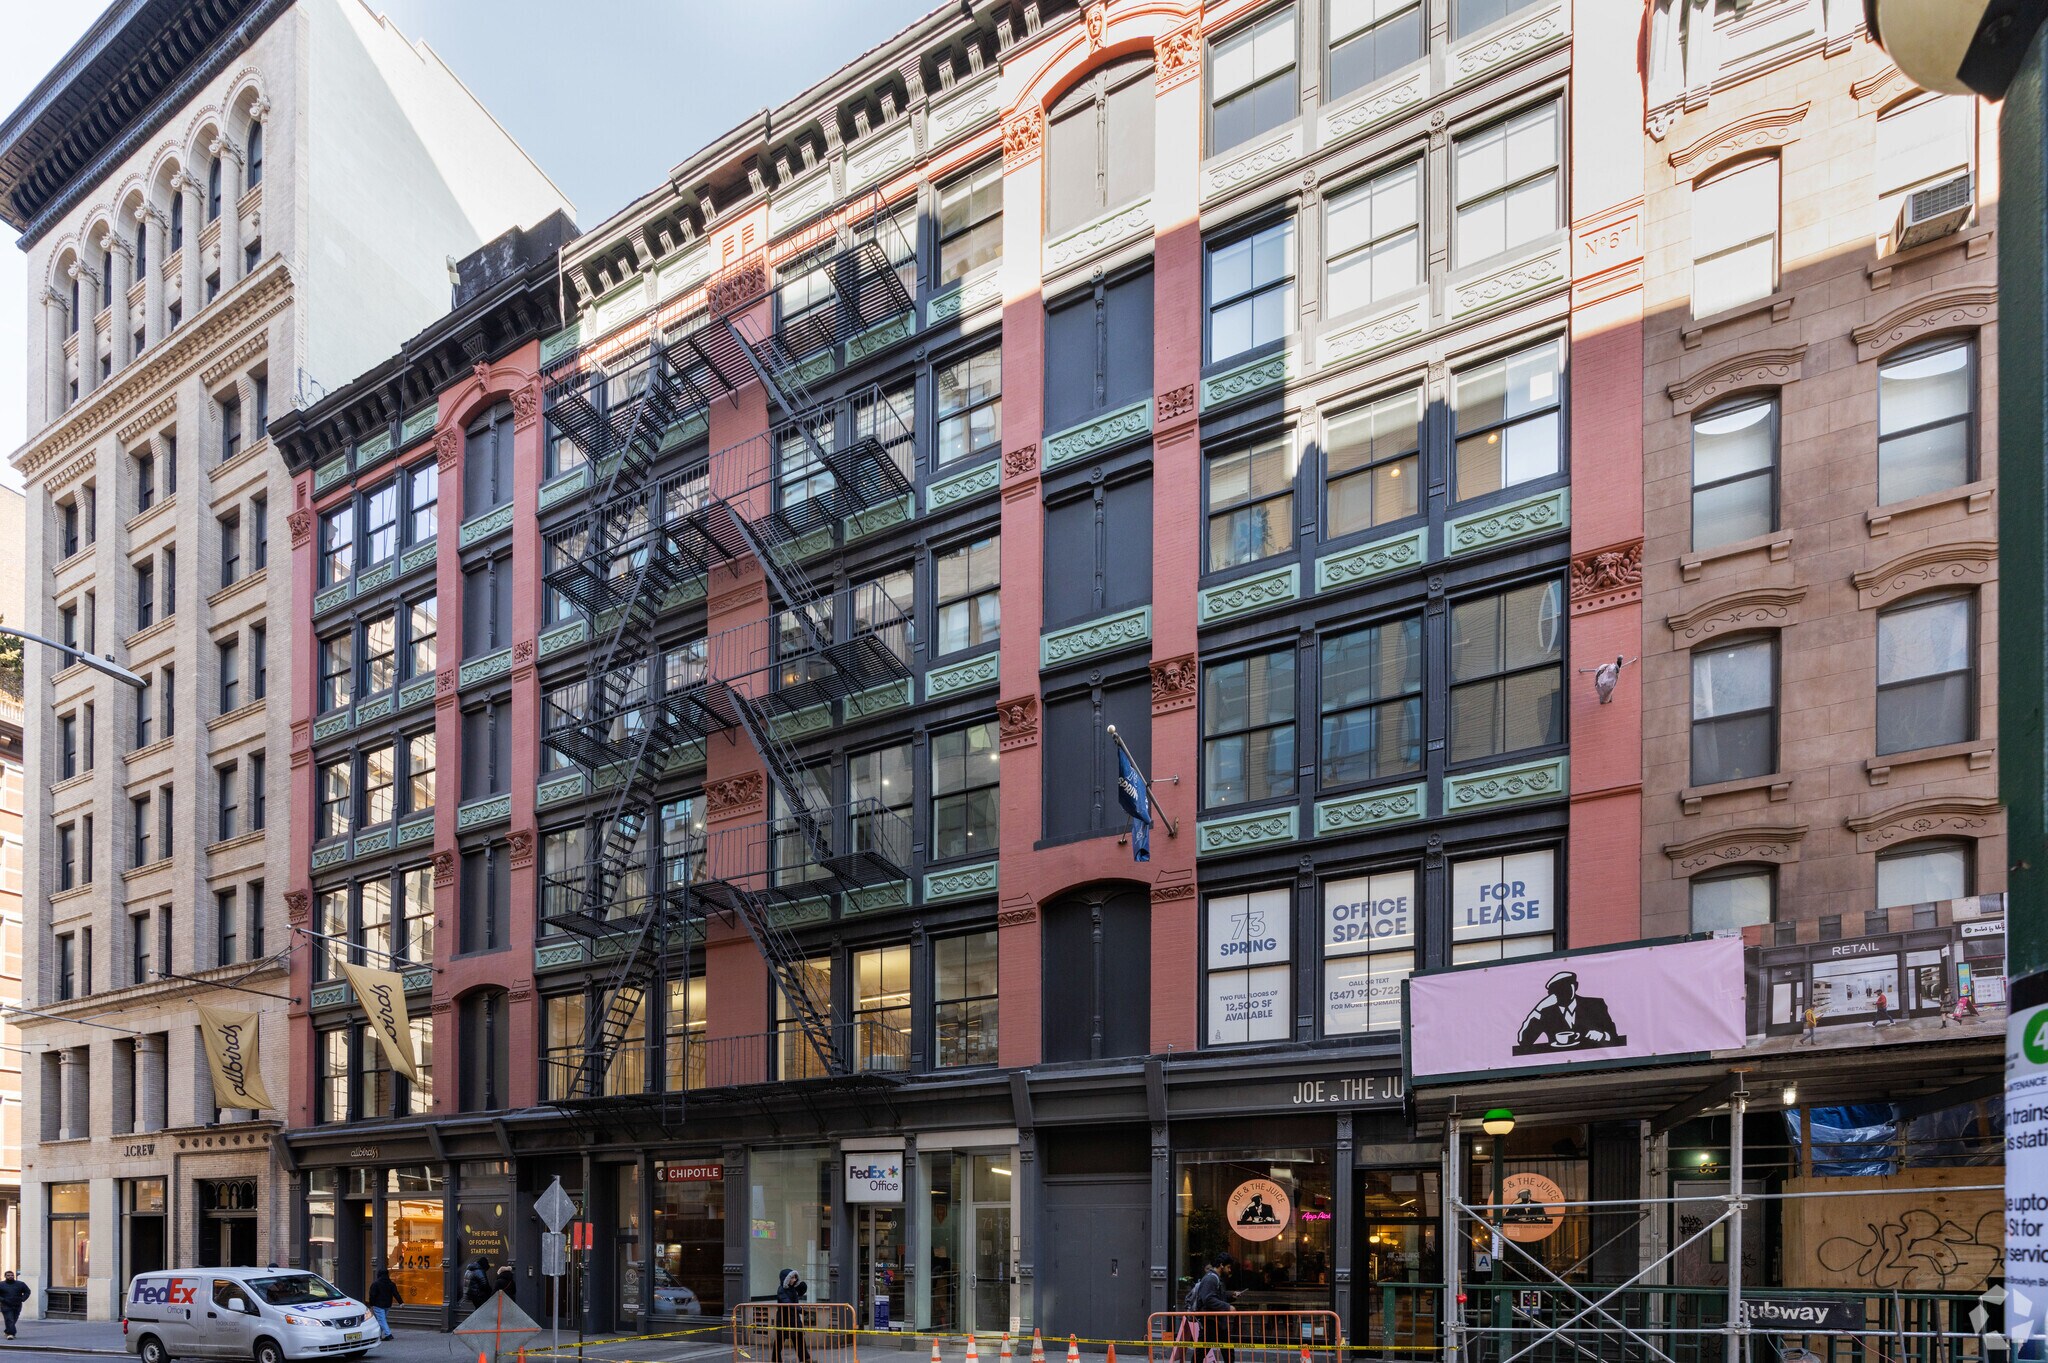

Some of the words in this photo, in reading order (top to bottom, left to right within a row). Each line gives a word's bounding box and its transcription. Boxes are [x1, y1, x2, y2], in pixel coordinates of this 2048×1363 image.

[1480, 881, 1526, 902] FOR
[1332, 896, 1407, 921] OFFICE
[1467, 900, 1539, 925] LEASE
[1231, 911, 1266, 940] 73
[1332, 917, 1407, 943] SPACE
[1220, 938, 1277, 956] SPRING
[1832, 942, 1880, 956] RETAIL
[1329, 989, 1355, 1001] (347)
[1357, 986, 1400, 998] 920-722
[1225, 1000, 1259, 1011] 12,500
[1262, 999, 1272, 1008] SF
[1225, 1009, 1273, 1022] AVAILABLE
[218, 1024, 247, 1097] allbirds
[1293, 1081, 1325, 1104] JOE
[1329, 1094, 1339, 1102] &
[1340, 1077, 1375, 1101] THE
[1382, 1076, 1404, 1098] JU
[124, 1144, 156, 1158] J.CREW
[669, 1167, 719, 1179] CHIPOTLE
[850, 1165, 886, 1179] FedEx
[1700, 1162, 1718, 1174] 65
[869, 1180, 898, 1191] Office
[1507, 1180, 1516, 1189] &
[1517, 1177, 1536, 1185] THE
[1536, 1181, 1560, 1201] JUICE
[1231, 1191, 1244, 1206] JOE
[1243, 1186, 1250, 1194] &
[1250, 1183, 1265, 1191] THE
[1265, 1186, 1286, 1204] JUICE
[2021, 1218, 2043, 1237] for
[658, 1246, 663, 1254] A
[1479, 1255, 1490, 1267] A
[132, 1278, 198, 1305] FedEx
[166, 1305, 184, 1315] Office
